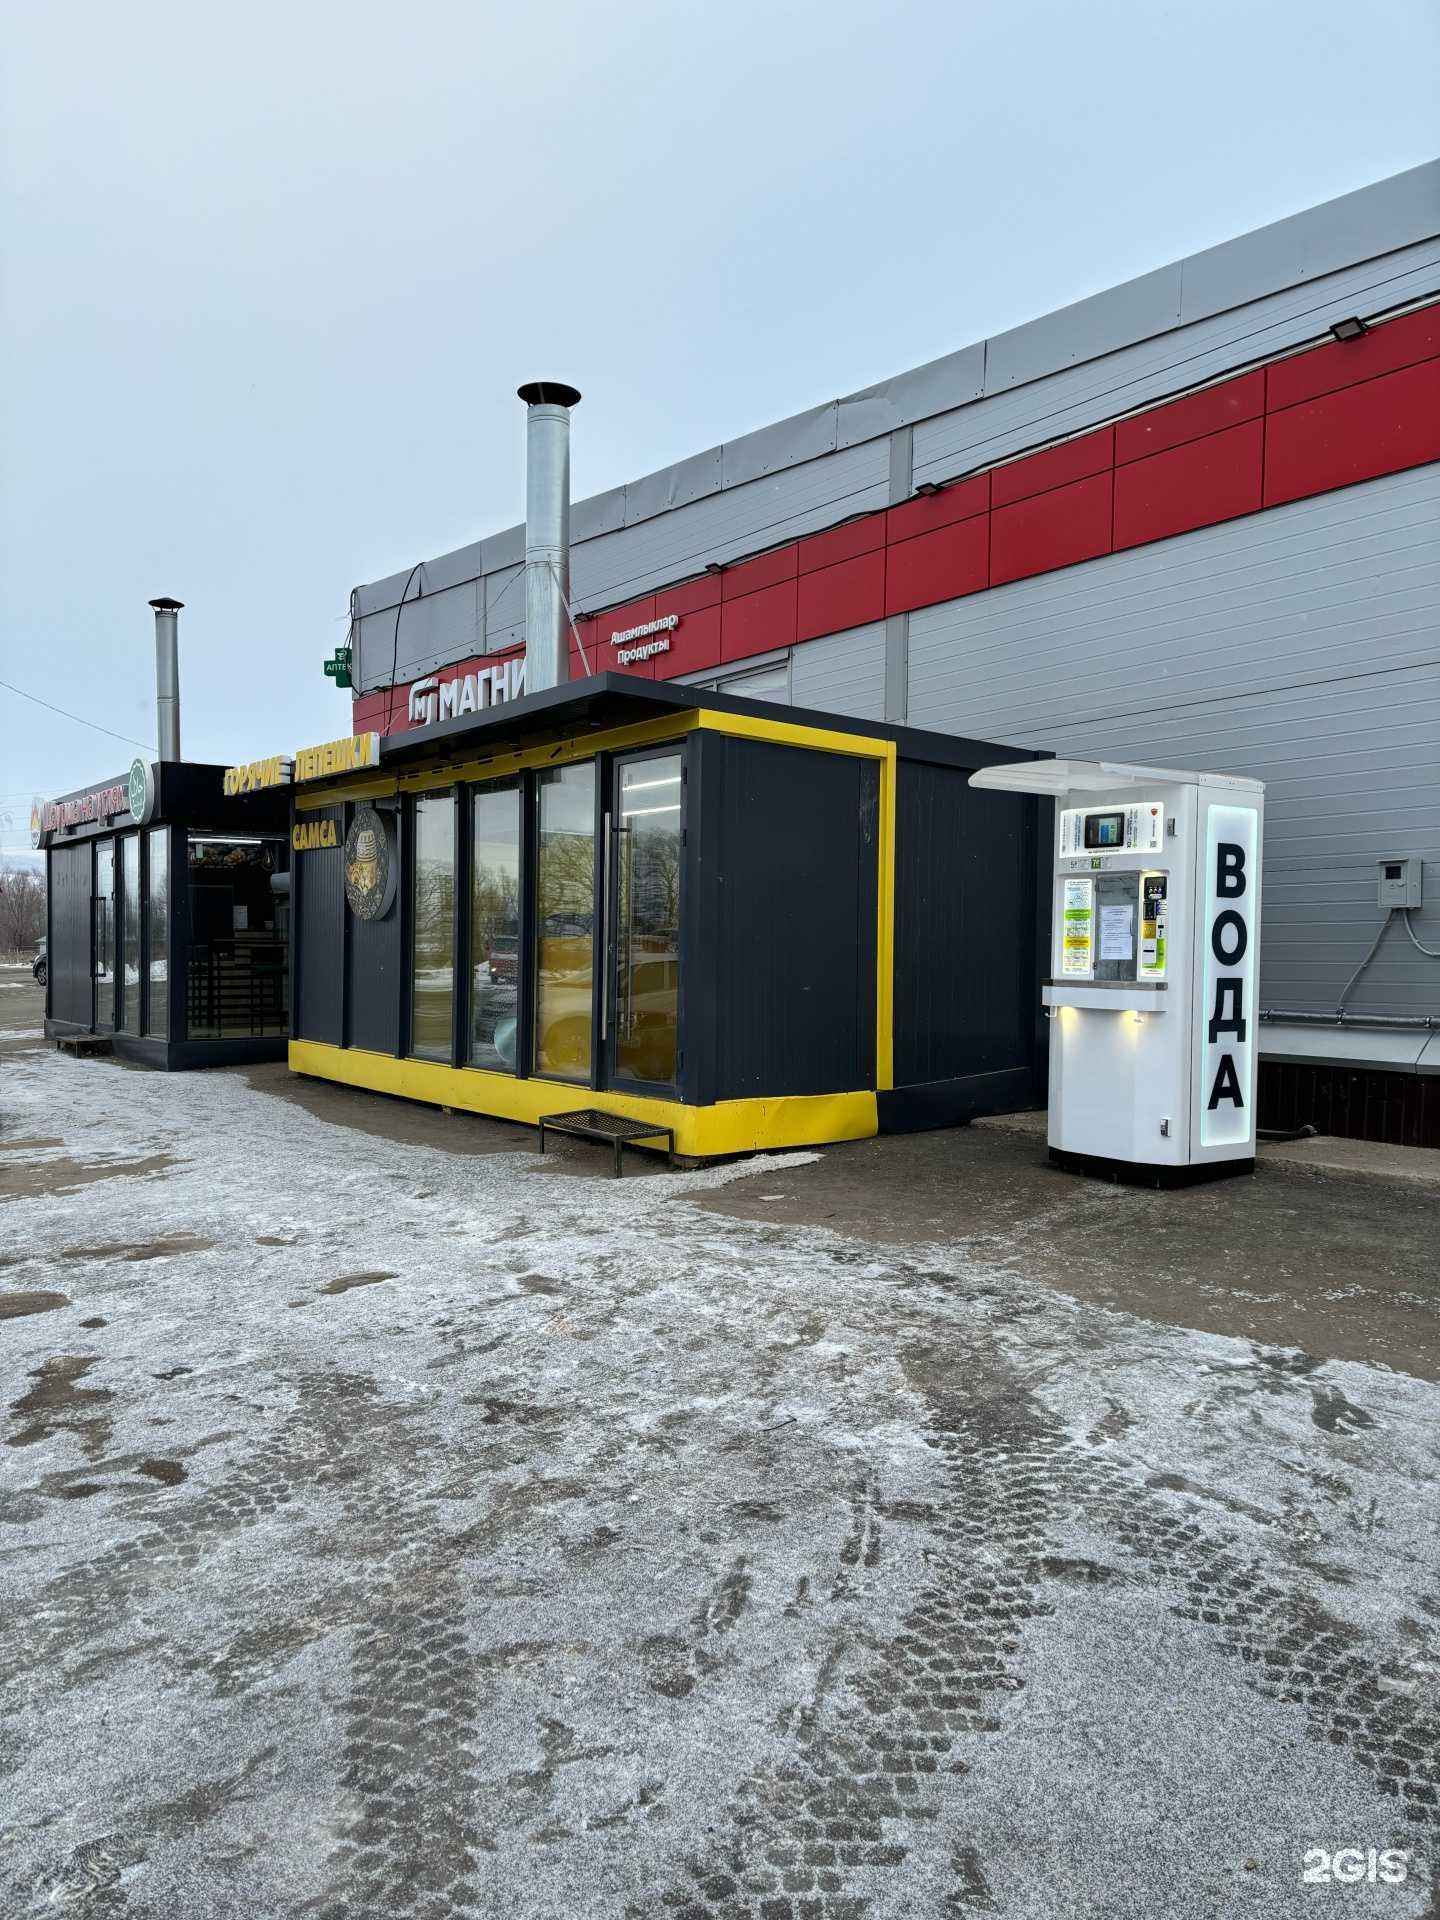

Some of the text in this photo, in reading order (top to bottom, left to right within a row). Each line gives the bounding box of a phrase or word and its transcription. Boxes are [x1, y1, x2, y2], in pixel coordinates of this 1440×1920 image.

[610, 614, 679, 646] Ашамлыклар
[617, 638, 670, 665] Продукты
[326, 663, 352, 673] АПТЕК
[439, 657, 527, 721] МАГНИ
[223, 732, 379, 796] ГОРЯЧИЕ ЛЕПЕШКИ
[292, 820, 337, 850] САМСА
[1207, 842, 1248, 1110] ВОДА
